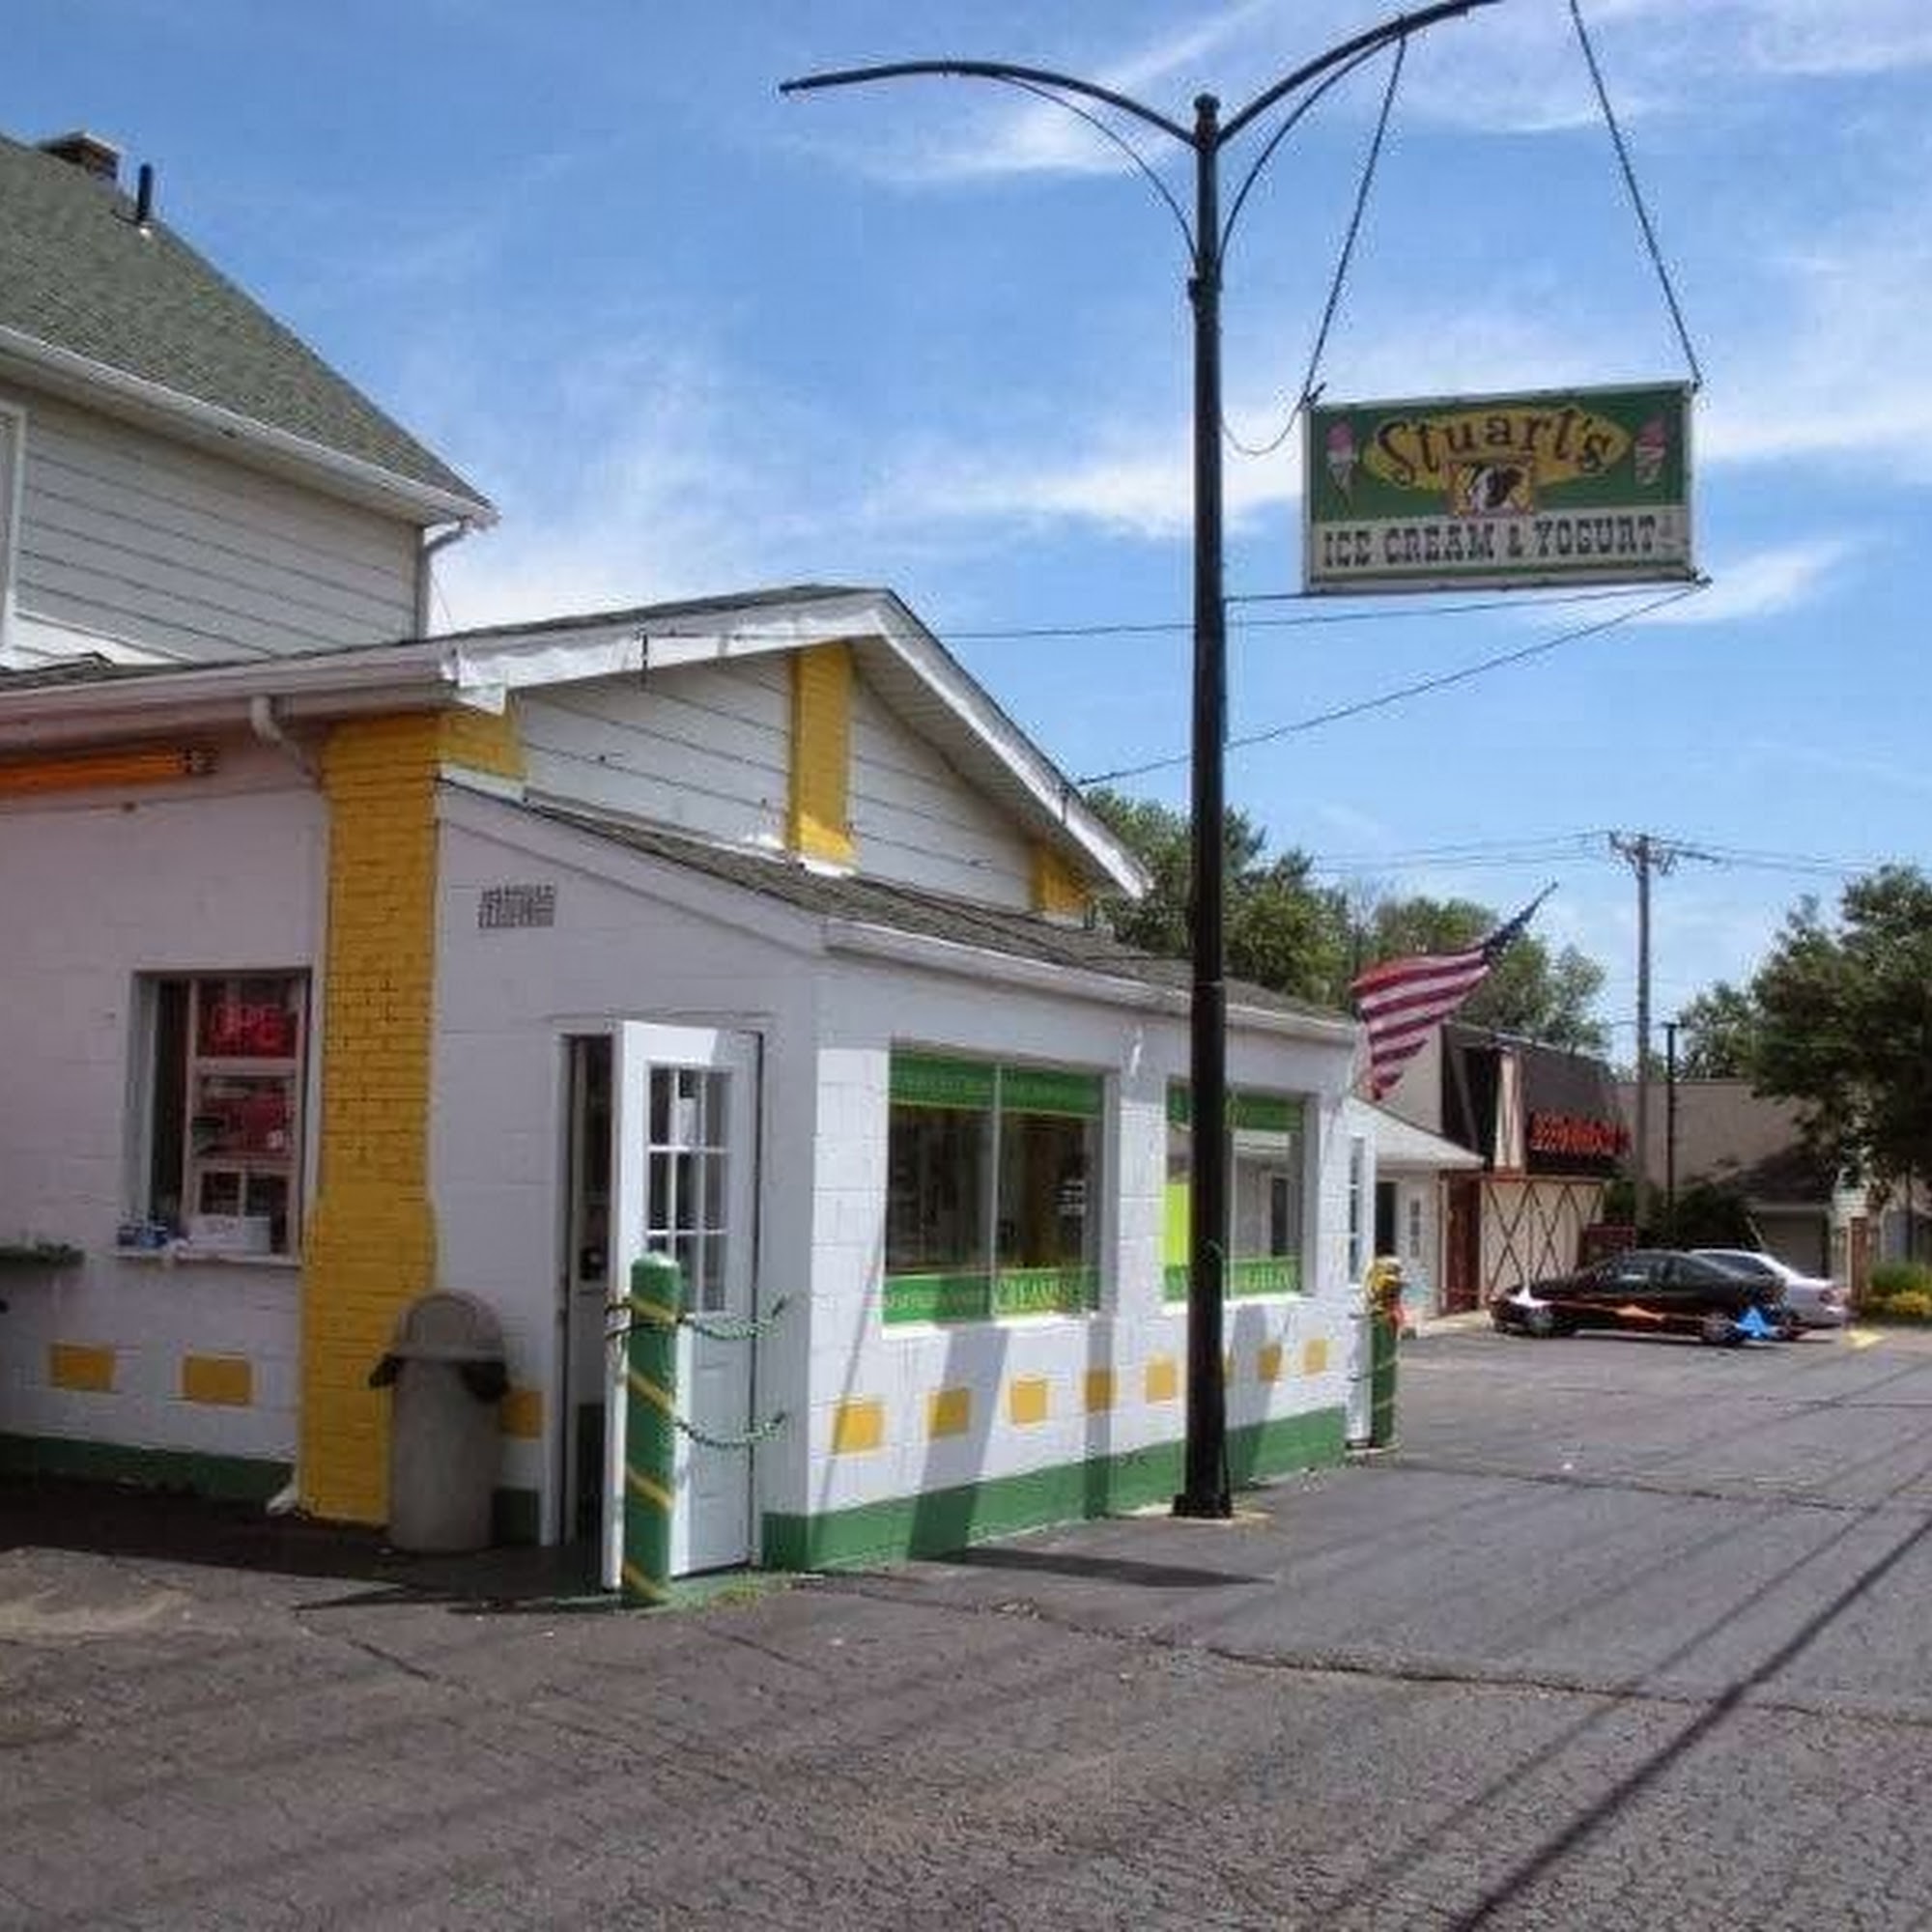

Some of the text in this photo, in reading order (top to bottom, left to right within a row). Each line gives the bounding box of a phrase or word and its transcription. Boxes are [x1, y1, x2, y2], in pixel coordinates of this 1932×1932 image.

[1377, 407, 1612, 486] Stuart's
[1324, 531, 1371, 567] ICE
[1384, 523, 1495, 563] CREAM
[1534, 515, 1657, 556] YOGURT
